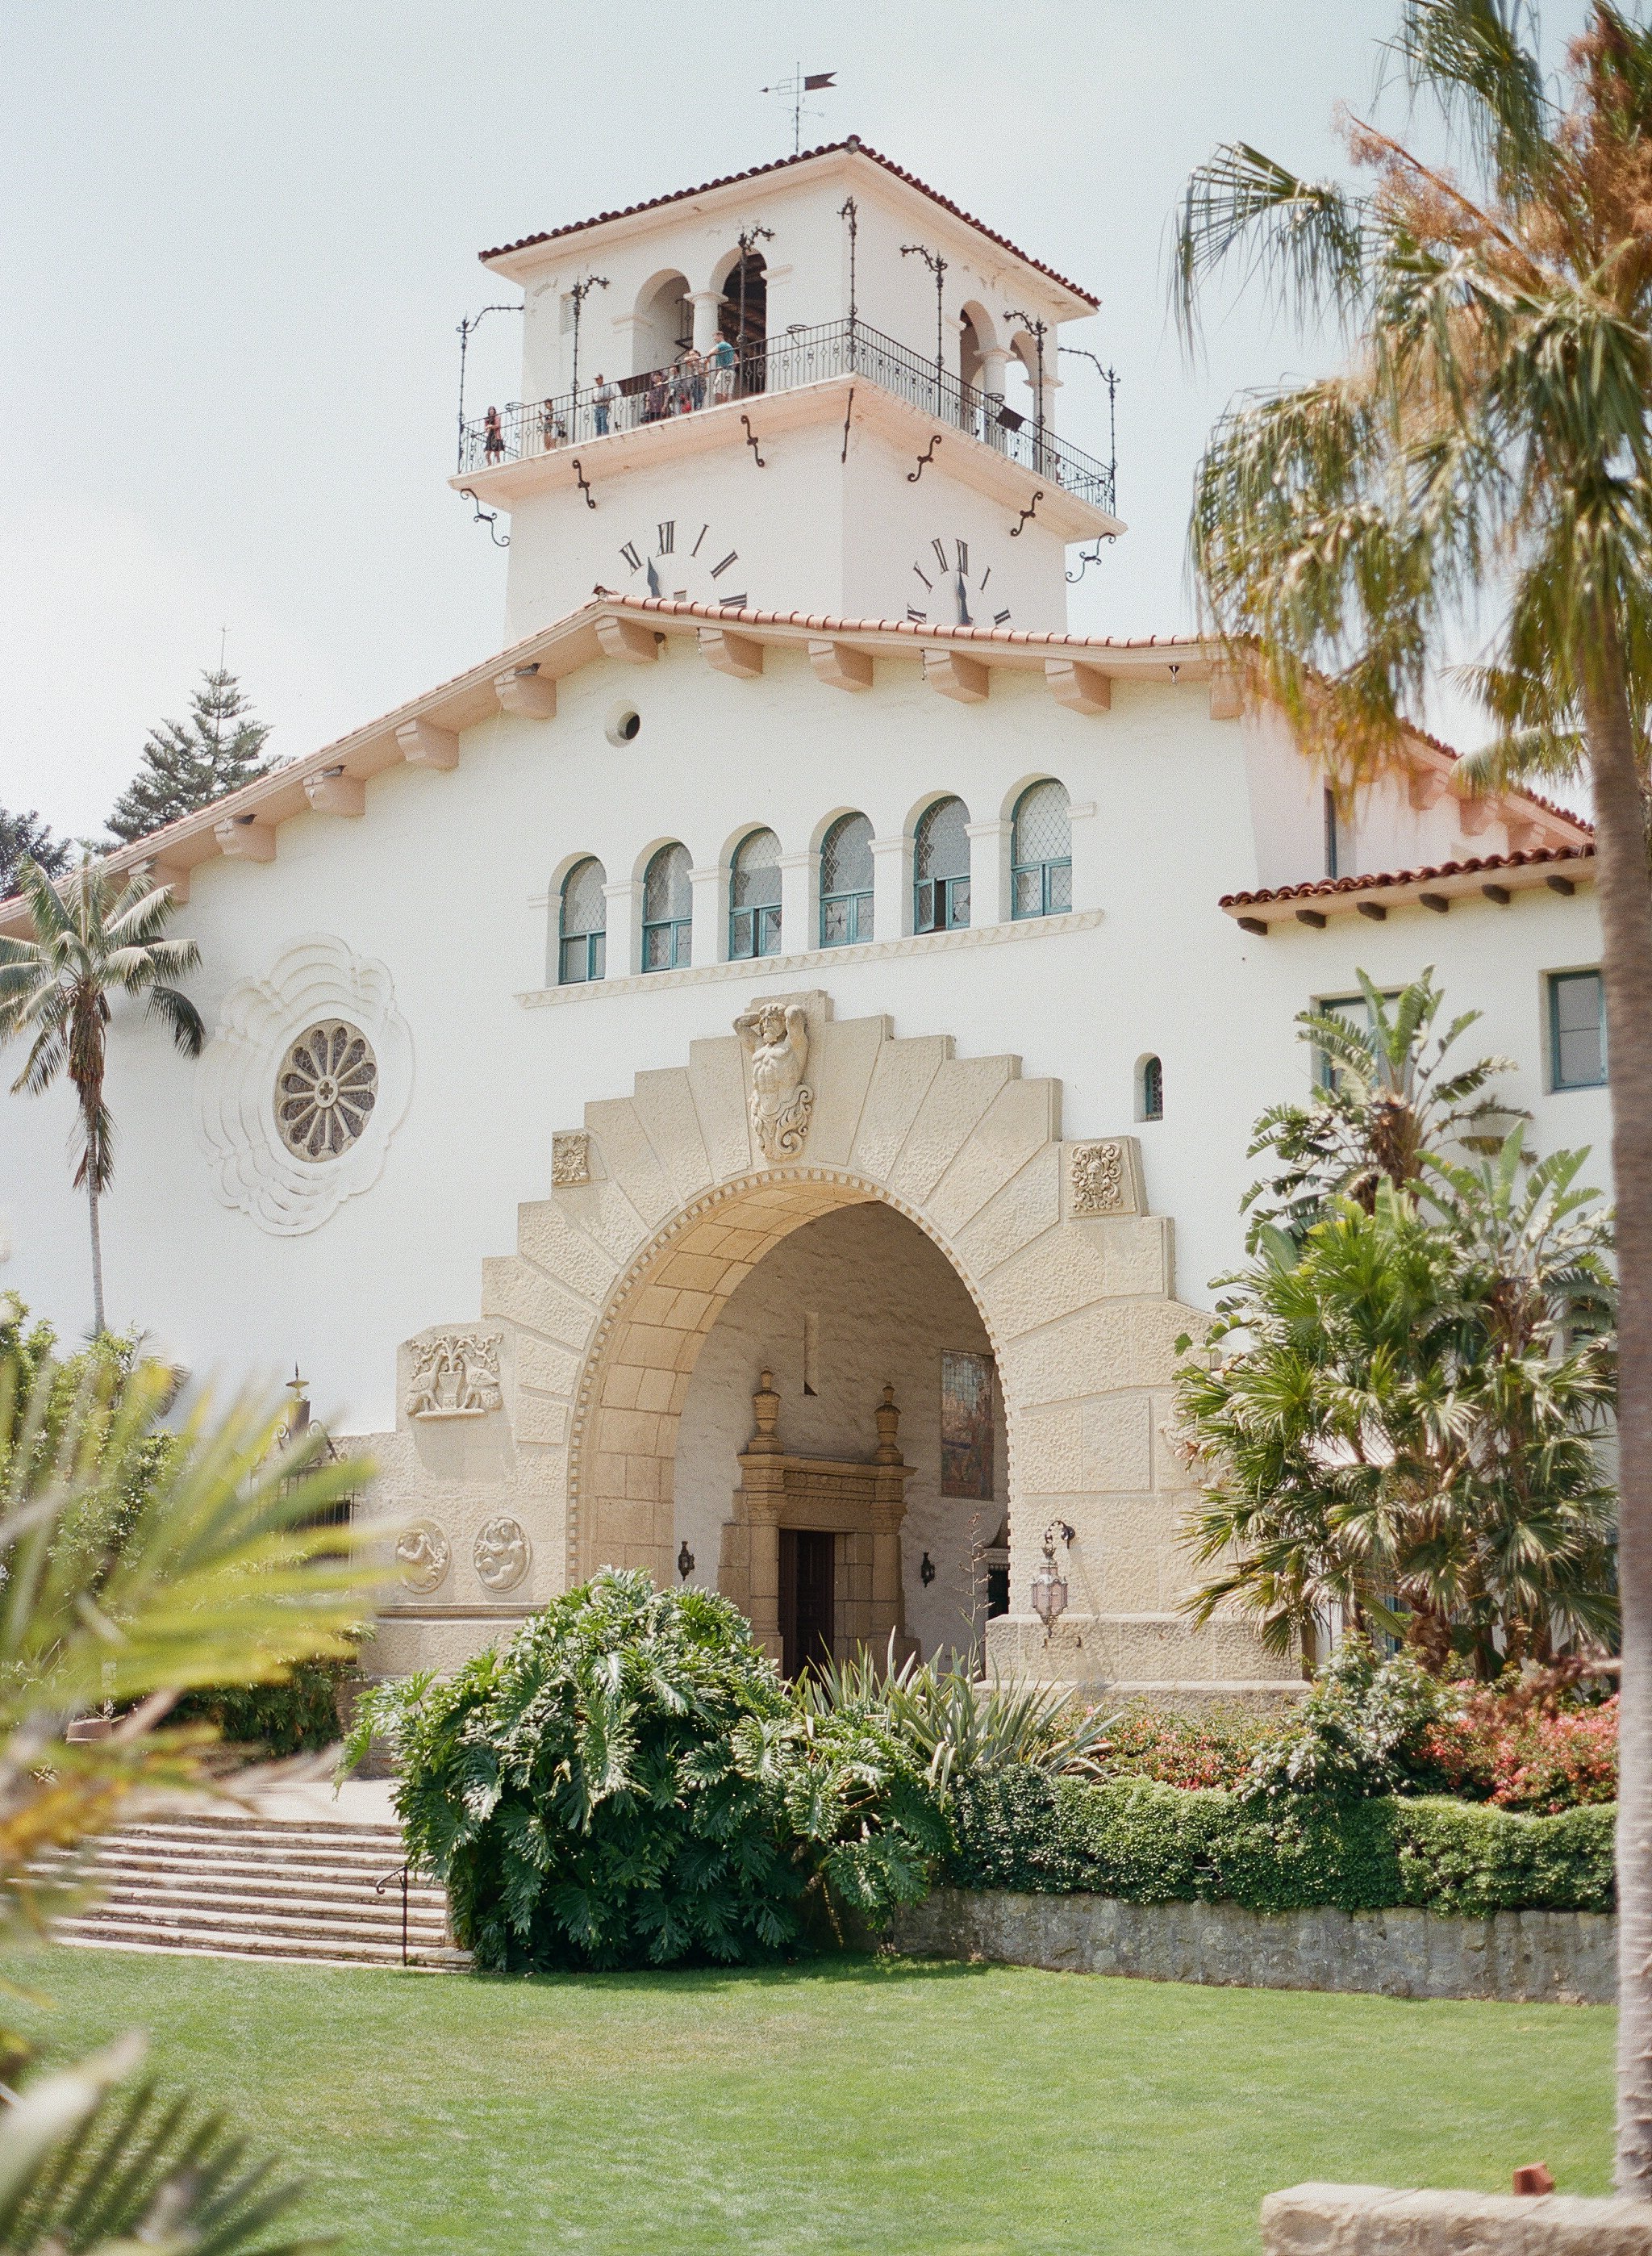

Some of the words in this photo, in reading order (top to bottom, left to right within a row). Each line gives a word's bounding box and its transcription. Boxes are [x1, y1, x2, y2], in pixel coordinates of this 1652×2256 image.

[656, 520, 676, 558] XII
[690, 524, 709, 557] I
[931, 538, 949, 575] XI
[619, 541, 645, 577] XI
[710, 549, 739, 580] II
[955, 538, 969, 577] XII
[913, 560, 933, 594] X
